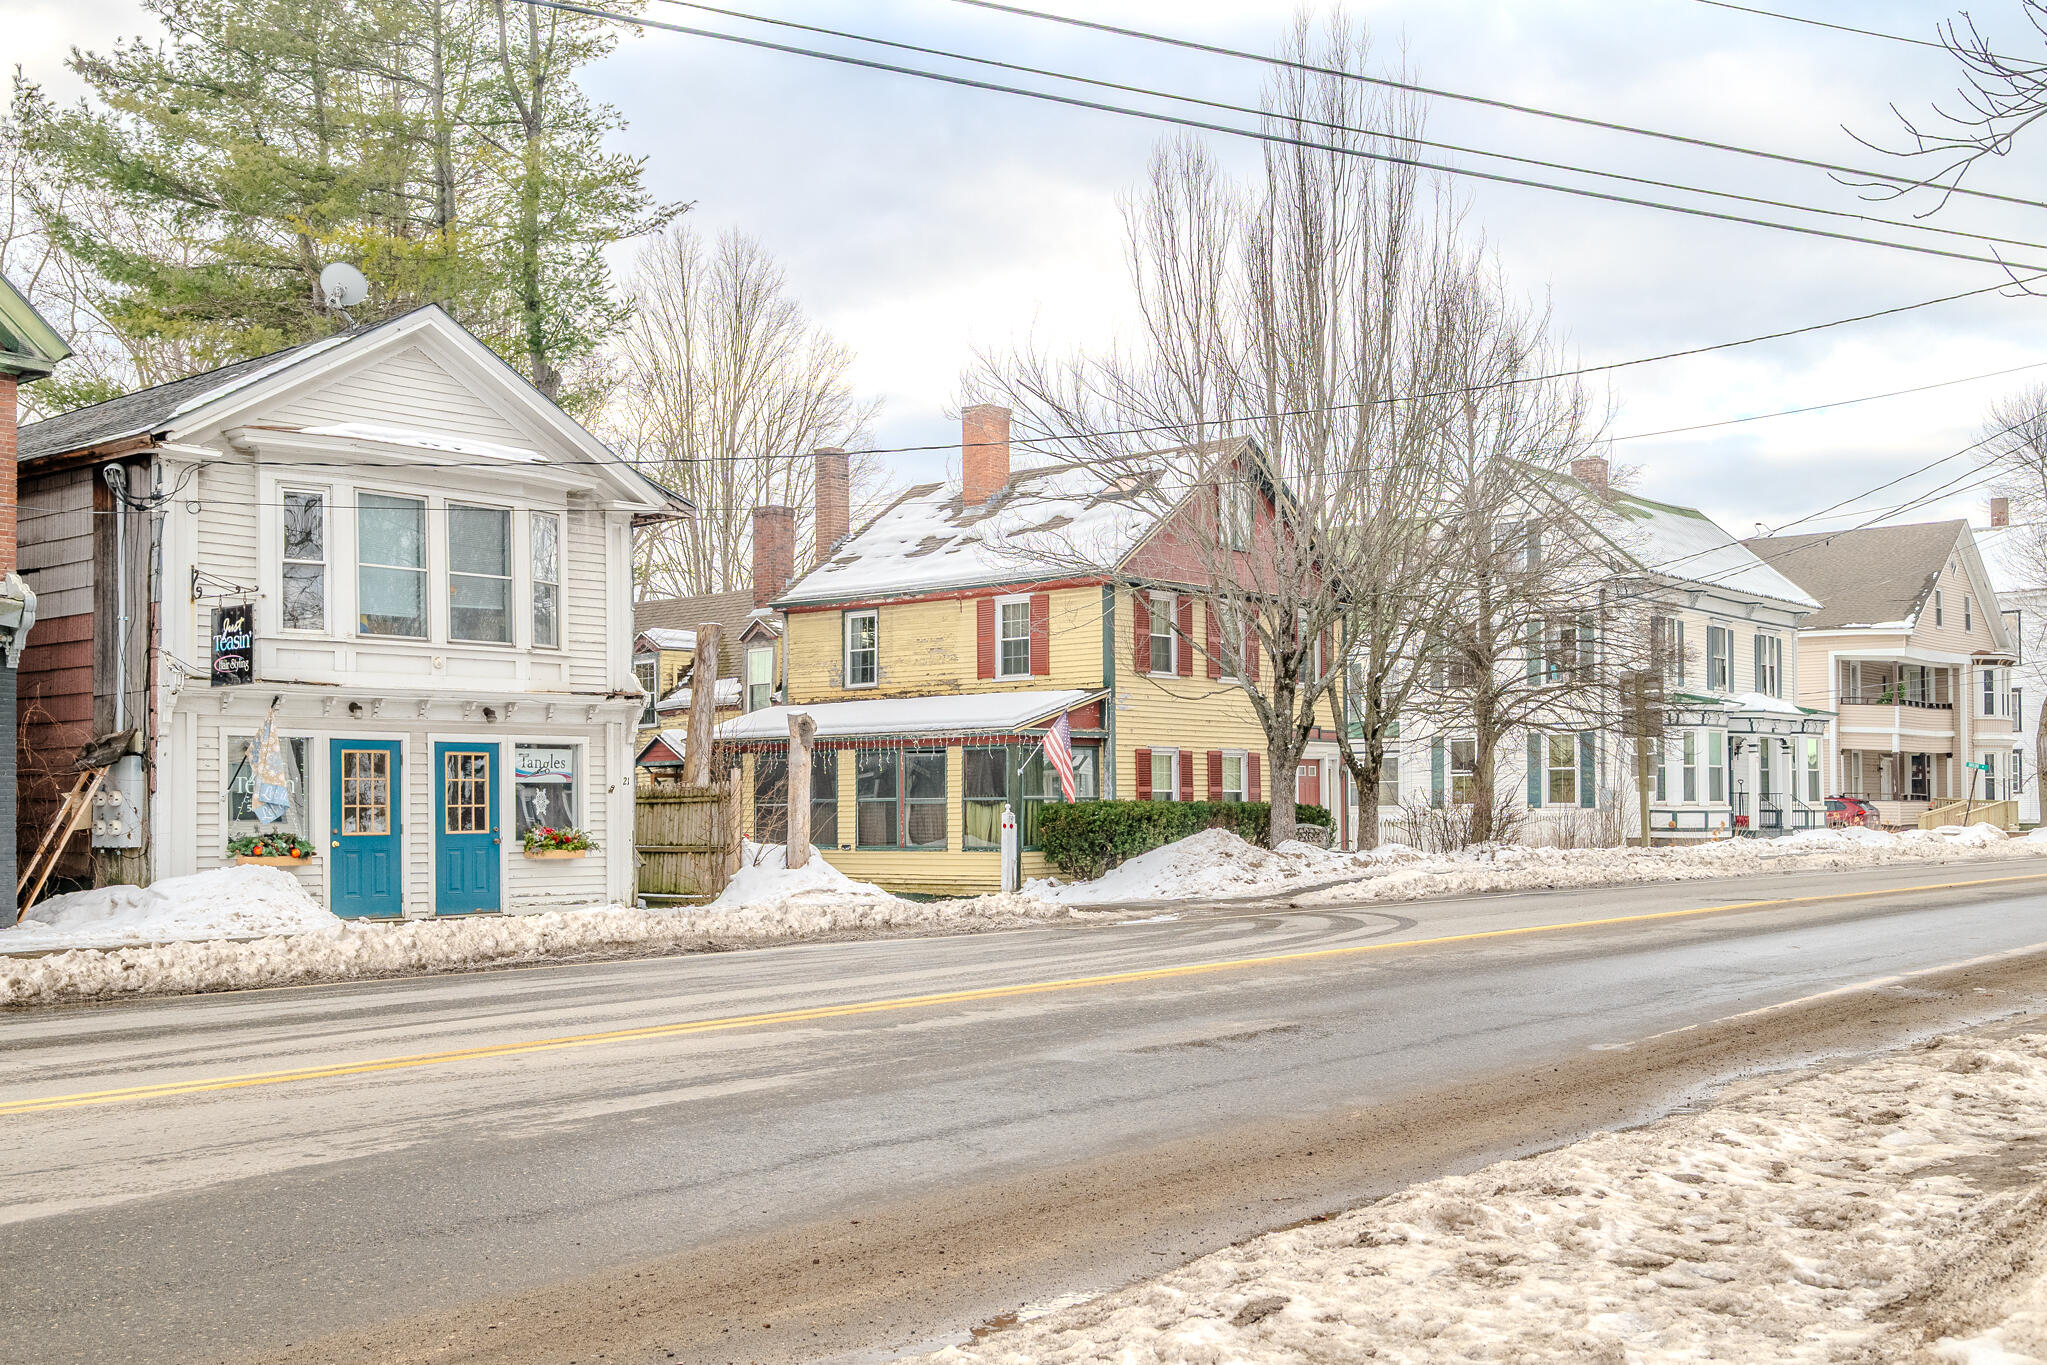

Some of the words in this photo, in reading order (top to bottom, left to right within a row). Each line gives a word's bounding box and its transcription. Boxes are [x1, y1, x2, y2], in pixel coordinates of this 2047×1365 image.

[222, 617, 245, 640] Just
[213, 631, 252, 652] Teasin'
[219, 660, 230, 670] Hair
[230, 658, 249, 672] Styling
[518, 753, 566, 772] Tangles
[236, 776, 298, 794] Ten'
[622, 777, 629, 785] 21
